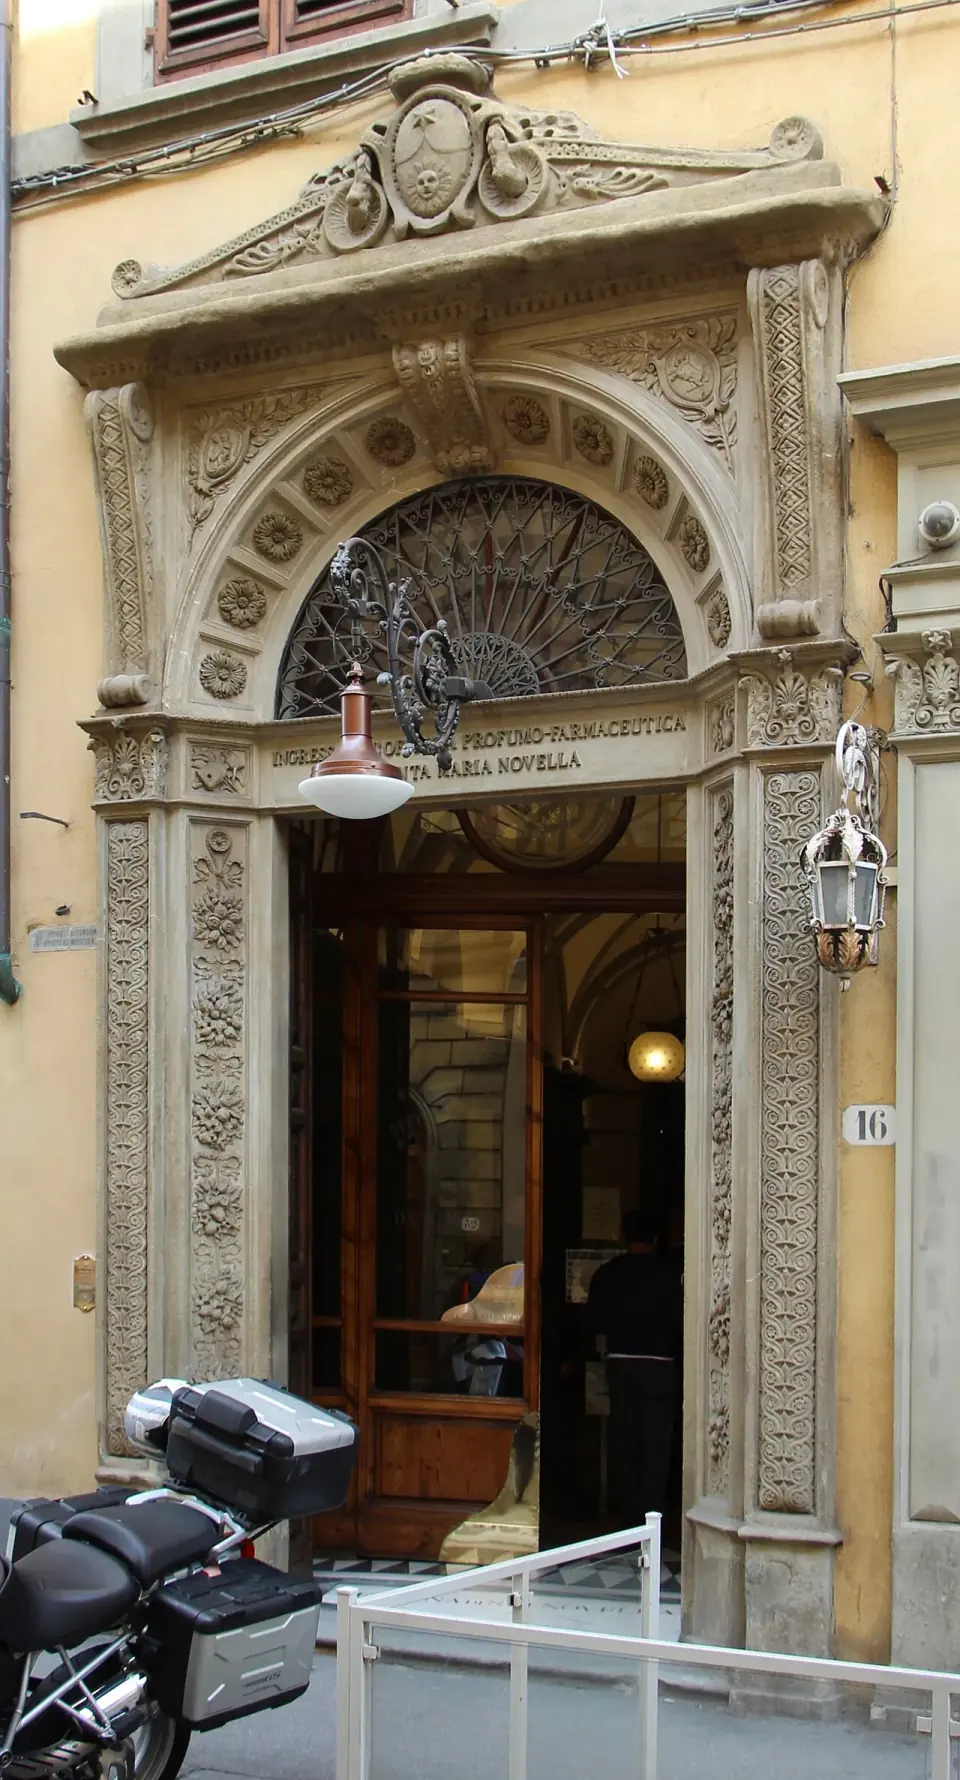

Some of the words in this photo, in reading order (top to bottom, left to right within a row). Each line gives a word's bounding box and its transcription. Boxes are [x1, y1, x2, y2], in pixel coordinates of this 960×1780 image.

[272, 746, 336, 767] INGRESS
[461, 715, 687, 750] PROFUMO-FARMACEUTICA
[498, 751, 581, 773] NOVELLA
[855, 1109, 887, 1141] 16
